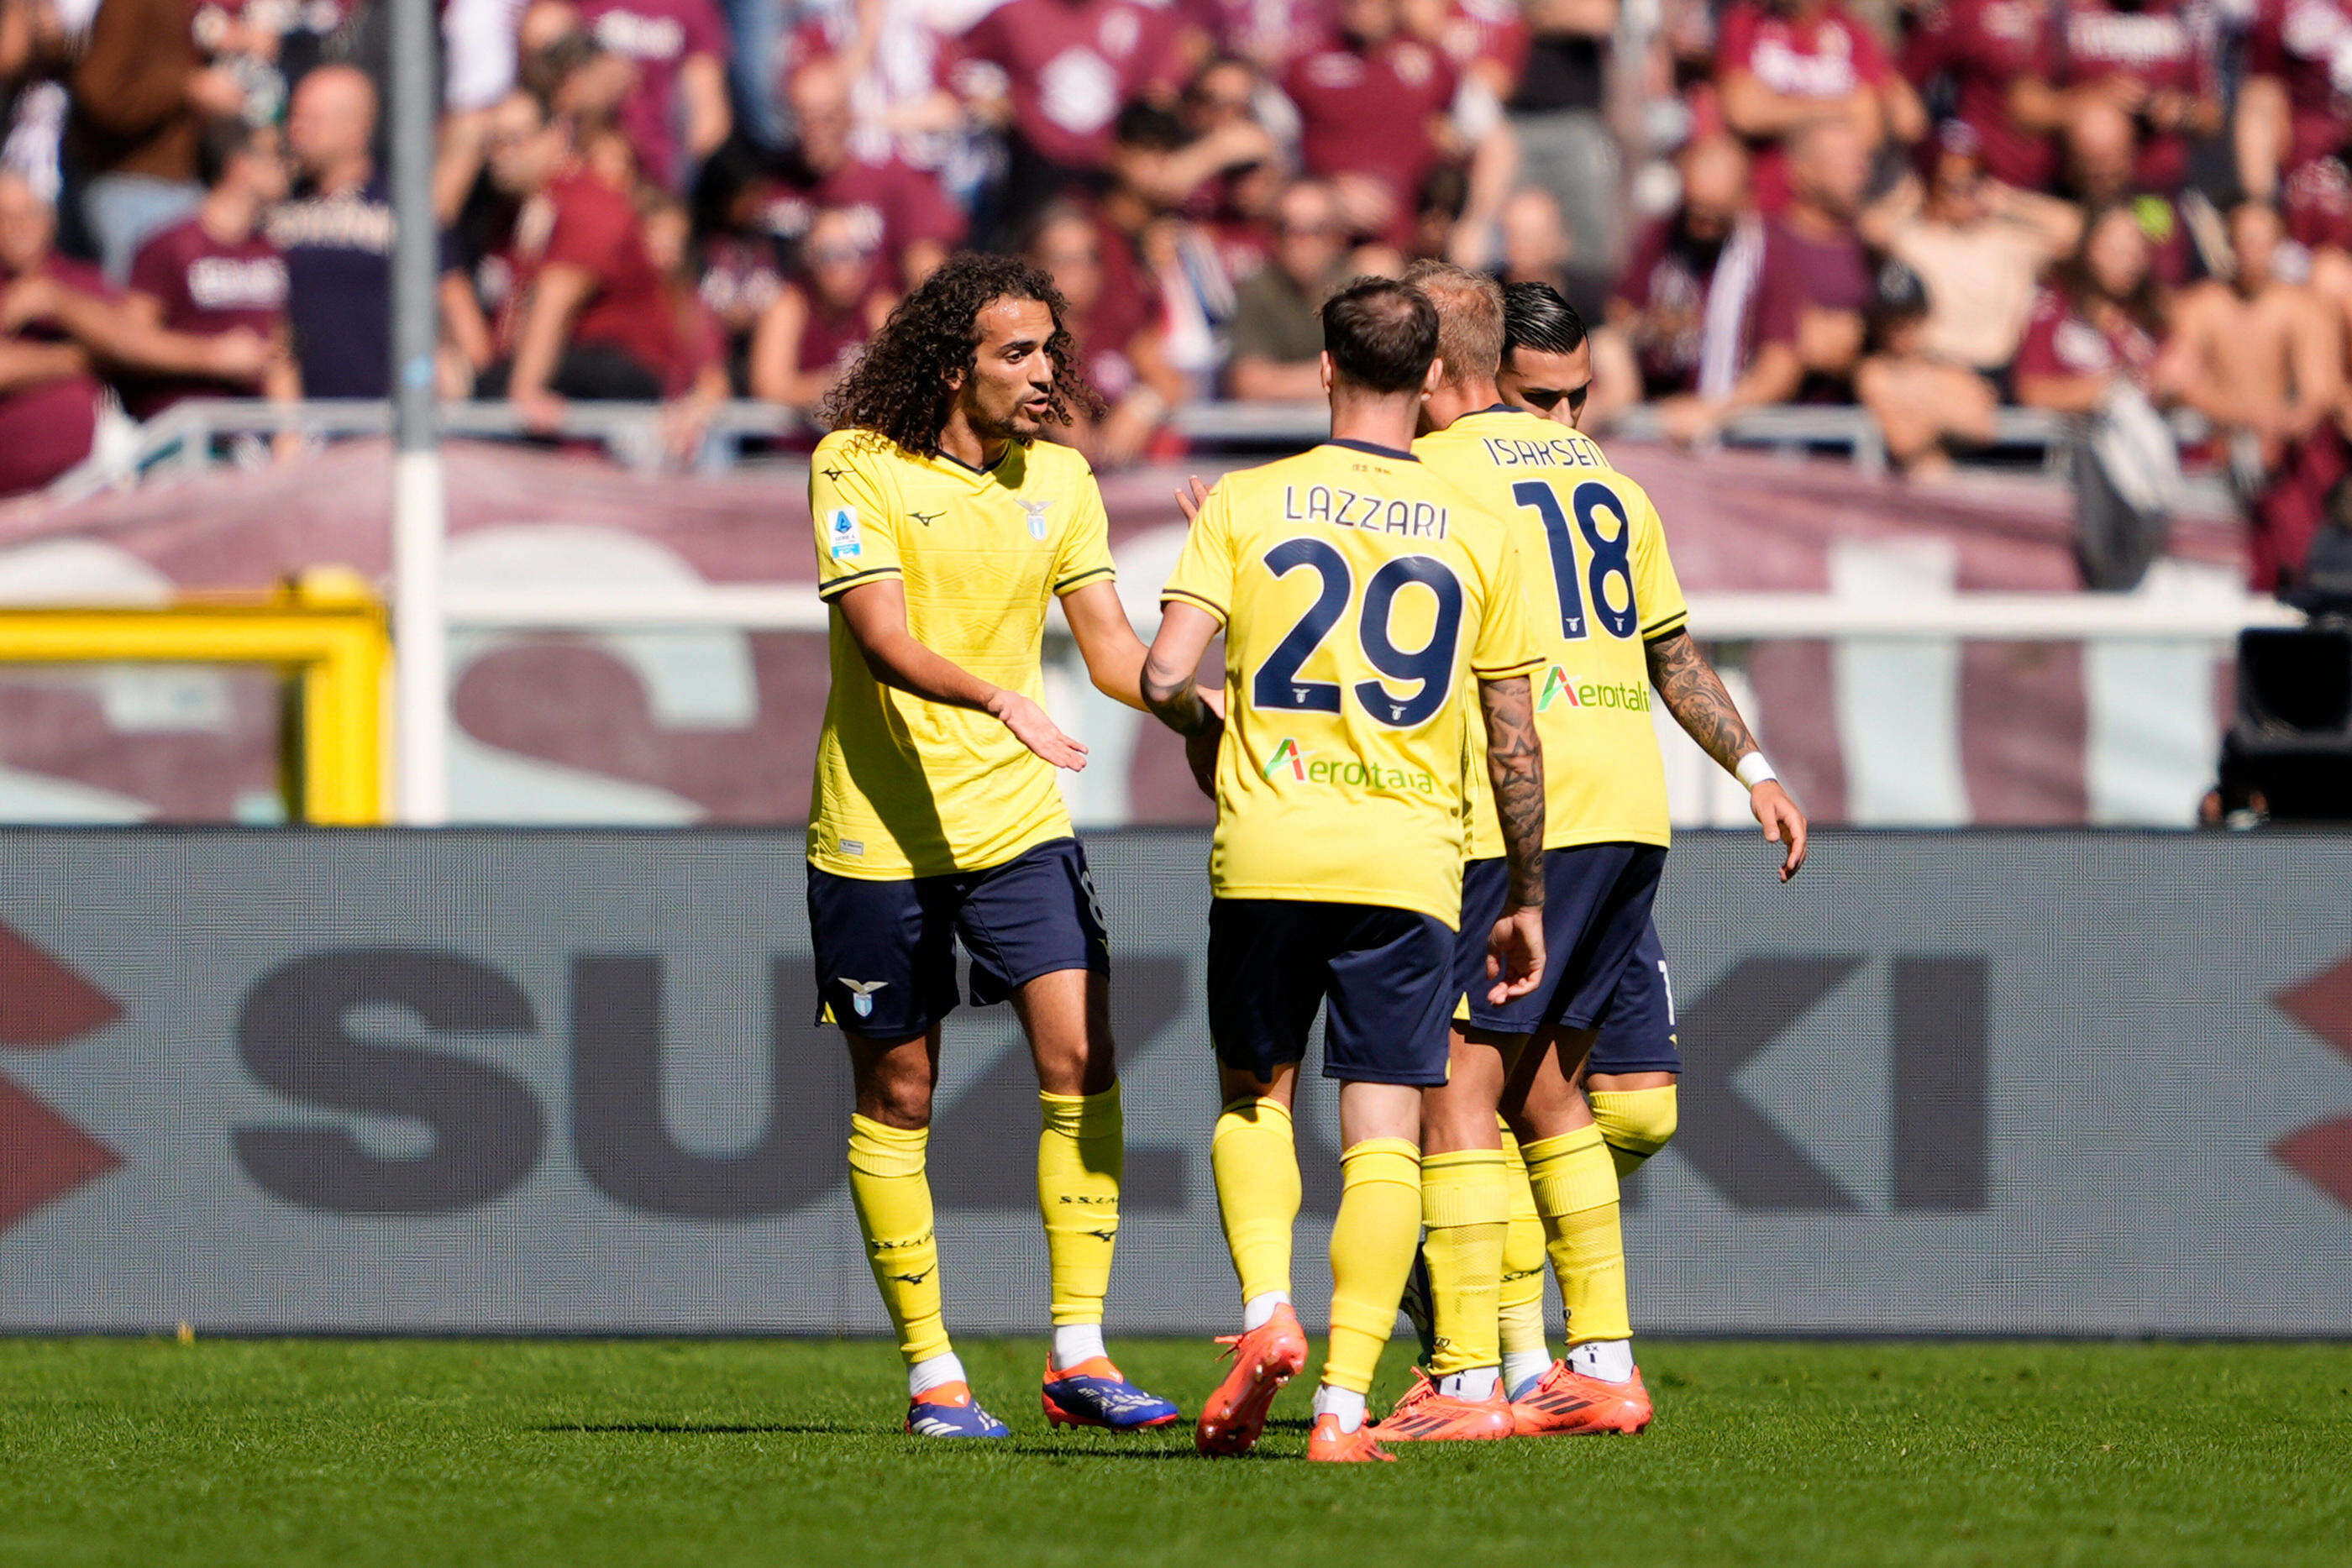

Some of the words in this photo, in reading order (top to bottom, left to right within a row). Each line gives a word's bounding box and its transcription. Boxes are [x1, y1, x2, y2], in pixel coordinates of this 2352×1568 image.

[1483, 437, 1609, 468] ISAKSEN
[1285, 485, 1447, 540] LAZZARI
[1510, 480, 1638, 640] 18
[1252, 537, 1465, 729] 29
[1537, 665, 1651, 713] Aeroitali
[232, 943, 1988, 1214] SUZKI
